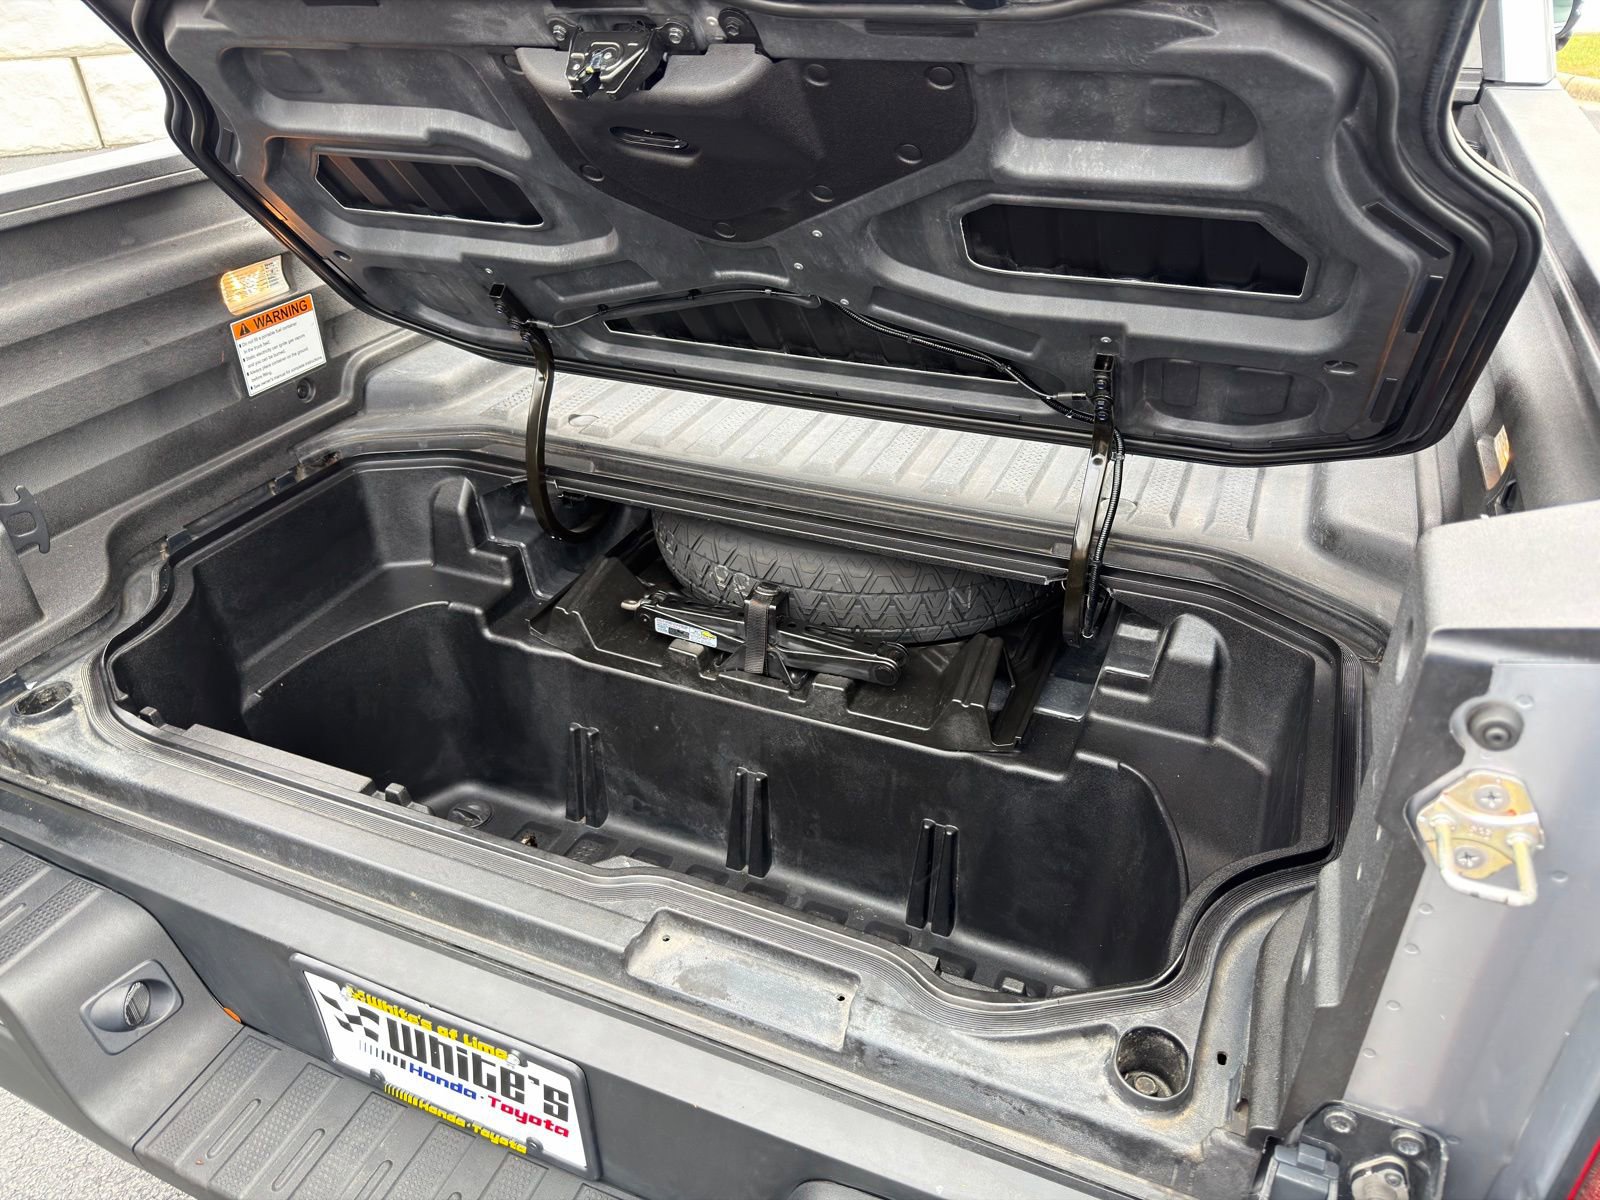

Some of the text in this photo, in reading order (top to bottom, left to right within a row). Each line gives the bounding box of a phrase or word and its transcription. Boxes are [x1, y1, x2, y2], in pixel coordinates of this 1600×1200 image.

[253, 300, 308, 329] WARNING
[365, 993, 432, 1031] White's
[464, 1034, 508, 1060] Lima
[386, 1017, 569, 1122] White's
[409, 1063, 569, 1138] Honda Toyota
[419, 1099, 527, 1154] Honda Toyota
